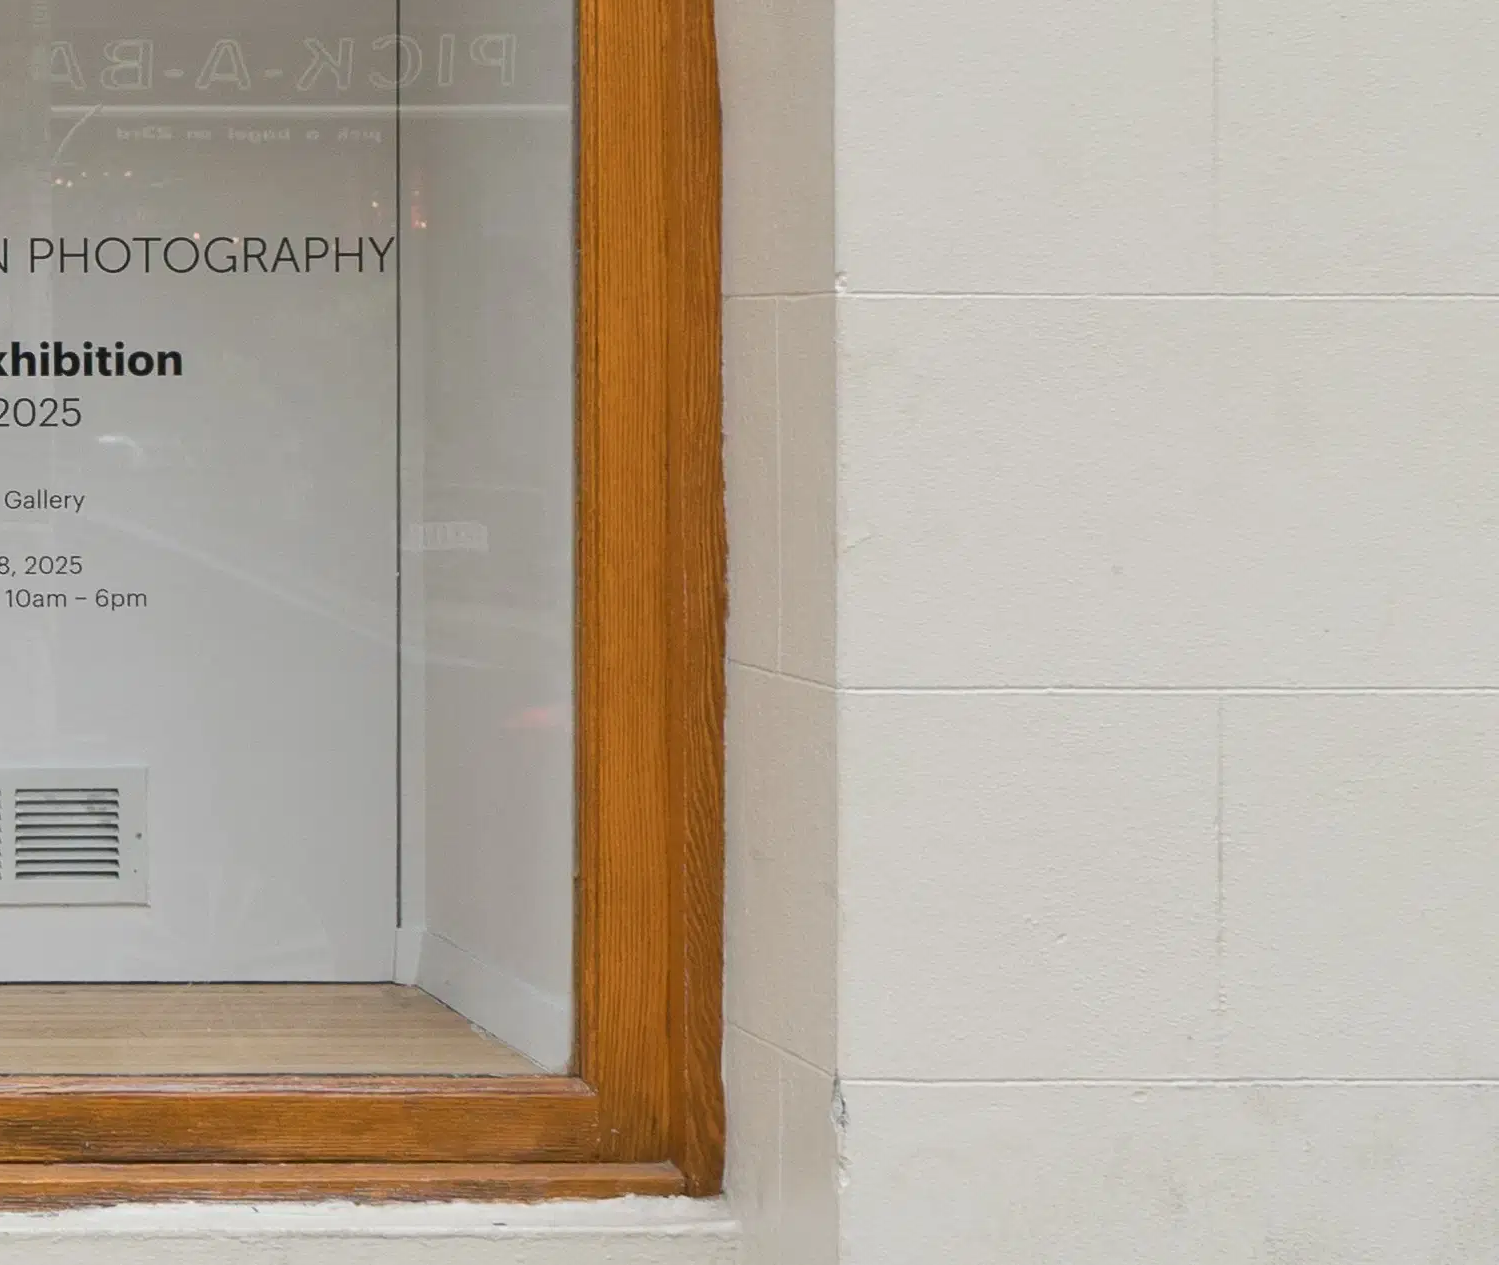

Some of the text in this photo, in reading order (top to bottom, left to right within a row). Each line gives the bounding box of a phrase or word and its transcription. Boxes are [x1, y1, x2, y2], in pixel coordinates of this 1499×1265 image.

[30, 236, 396, 274] PHOTOGRAPHY
[4, 488, 86, 514] Gallery
[24, 555, 83, 575] 2025
[5, 588, 67, 608] 10am
[95, 588, 147, 612] 6pm
